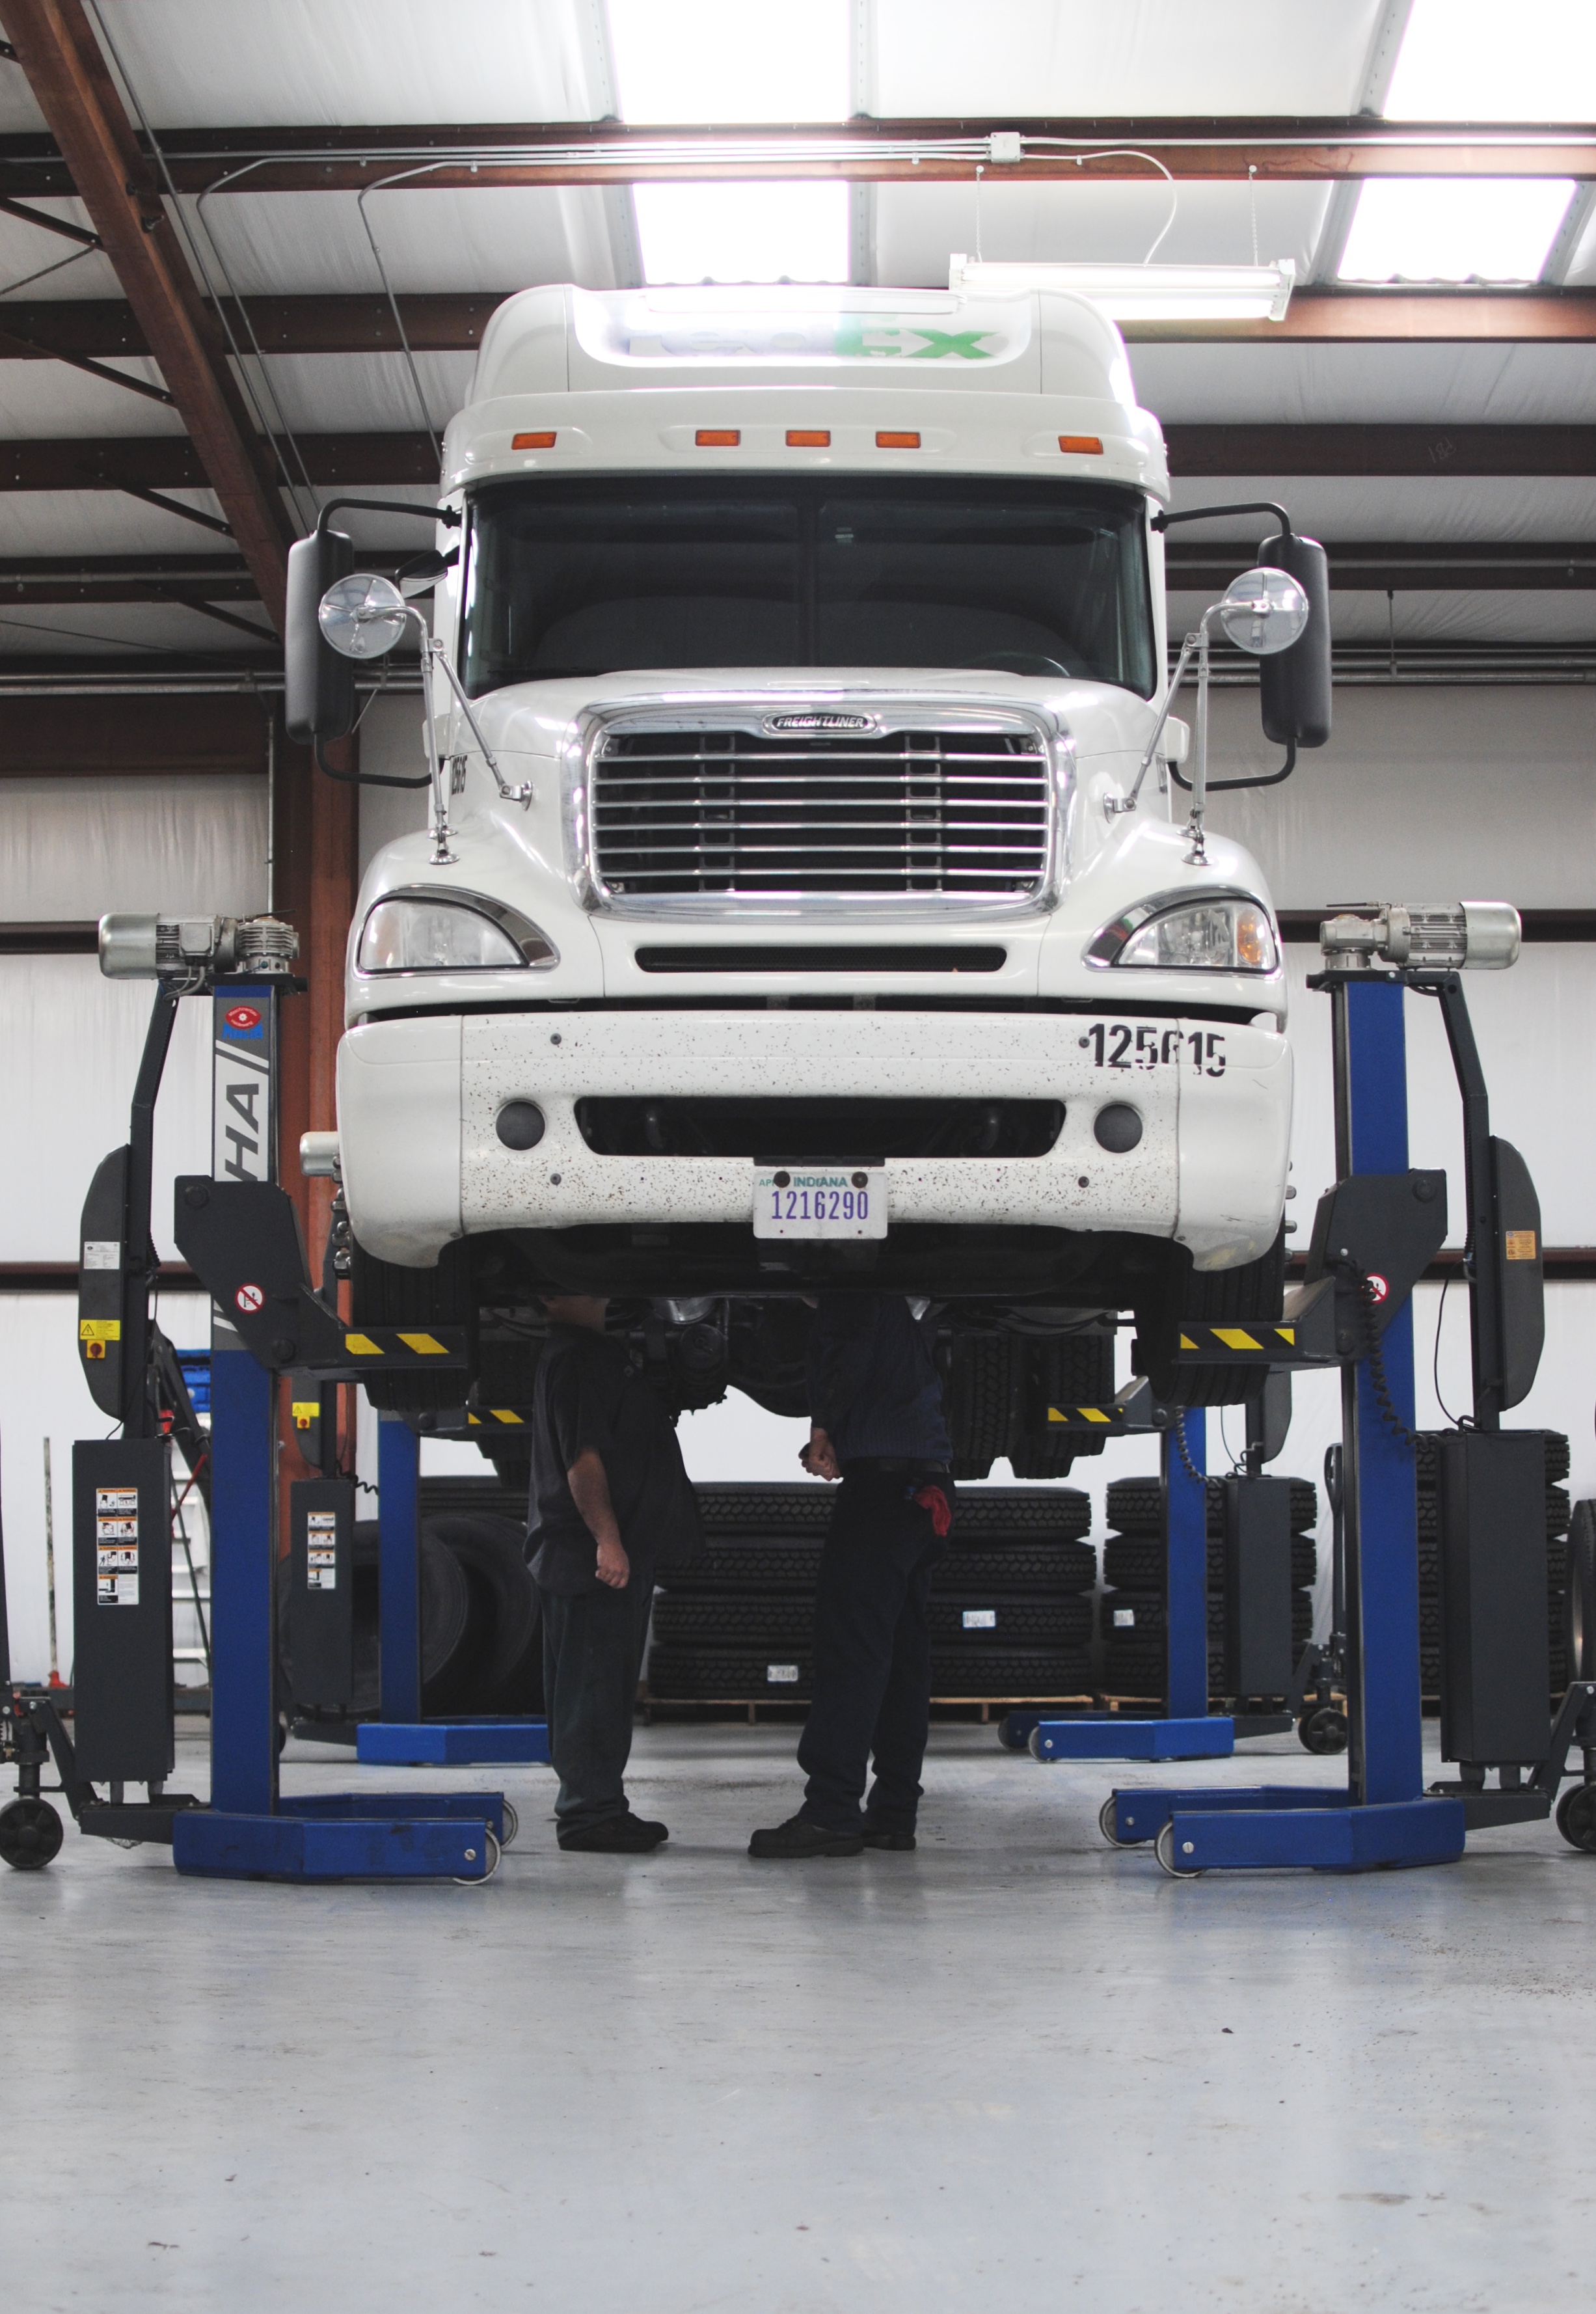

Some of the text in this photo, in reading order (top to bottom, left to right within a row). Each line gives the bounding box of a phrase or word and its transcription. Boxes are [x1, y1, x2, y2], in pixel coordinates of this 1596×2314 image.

[776, 716, 864, 728] FREIGHTLINER
[759, 1177, 848, 1188] AP INDIANA
[771, 1190, 869, 1219] 1216290
